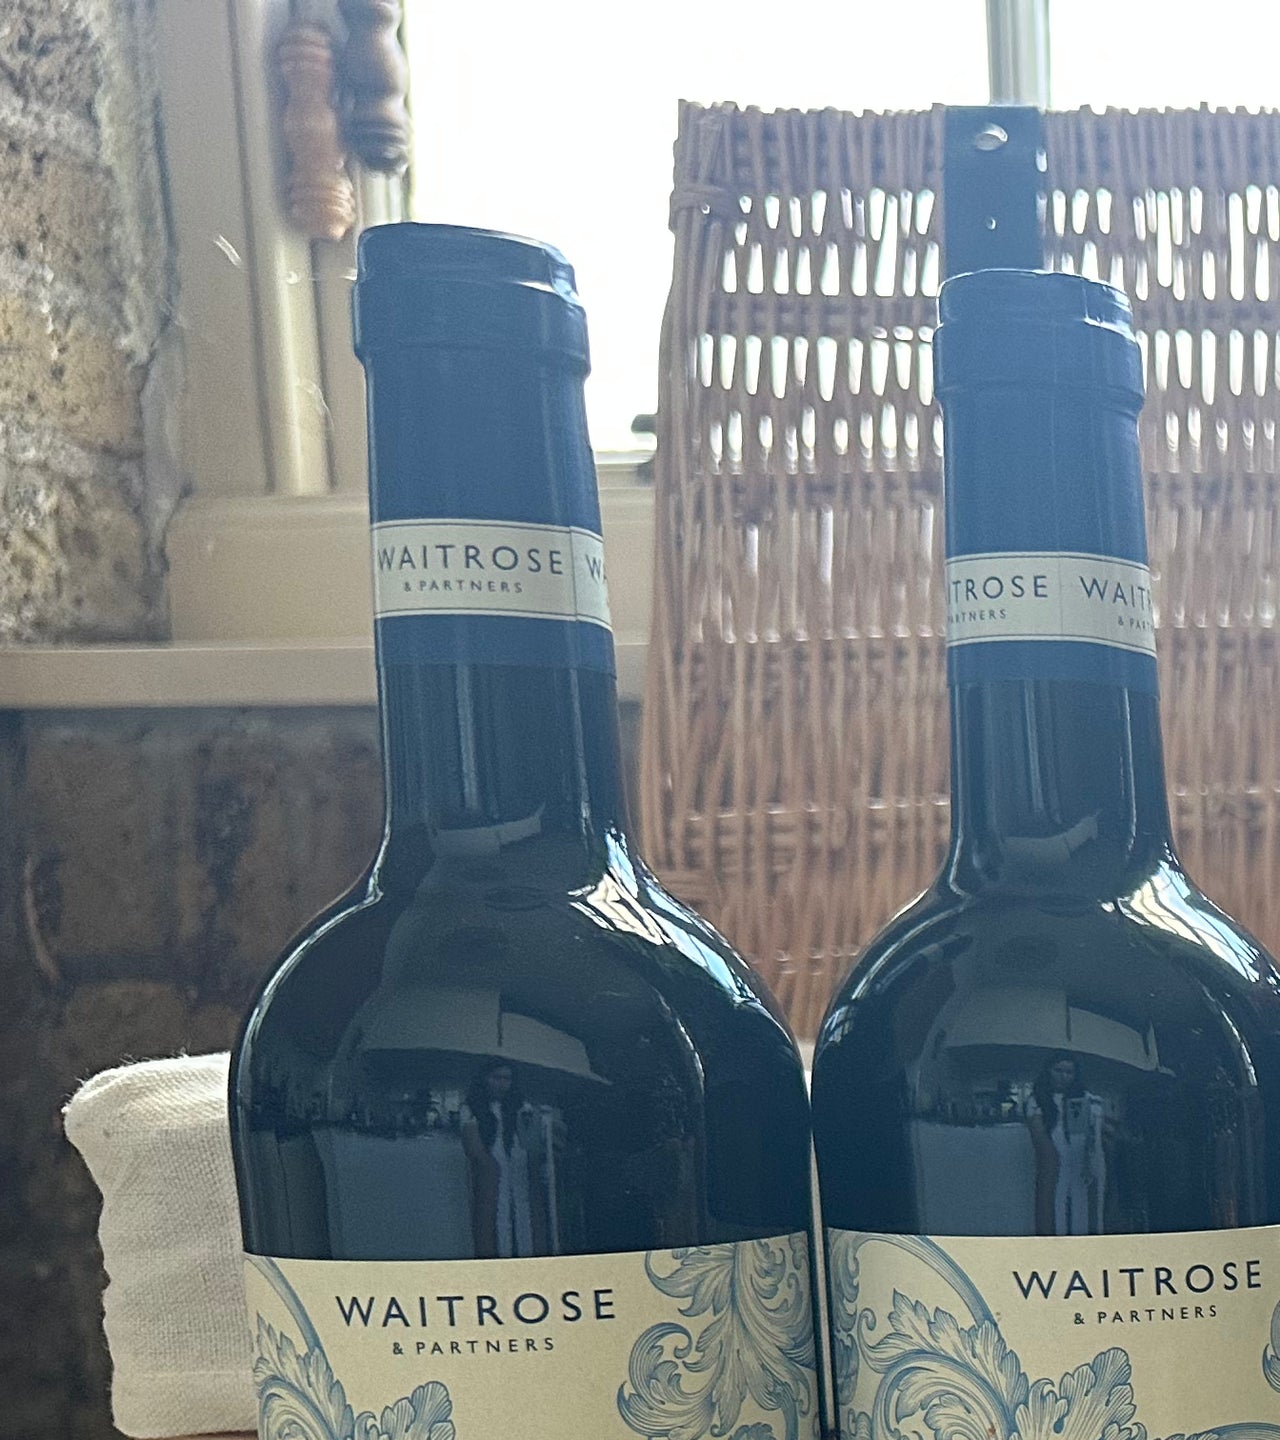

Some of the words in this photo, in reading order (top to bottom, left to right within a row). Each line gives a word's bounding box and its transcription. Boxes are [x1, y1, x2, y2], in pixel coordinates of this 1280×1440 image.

[377, 544, 564, 575] WAITROSE
[403, 581, 412, 593] &
[419, 580, 523, 594] PARTNERS
[1012, 1259, 1262, 1299] WAITROSE
[335, 1289, 616, 1327] WAITROSE
[1073, 1312, 1085, 1325] &
[1097, 1304, 1217, 1324] PARTNERS
[392, 1342, 404, 1355] &
[416, 1337, 555, 1355] PARTNERS
